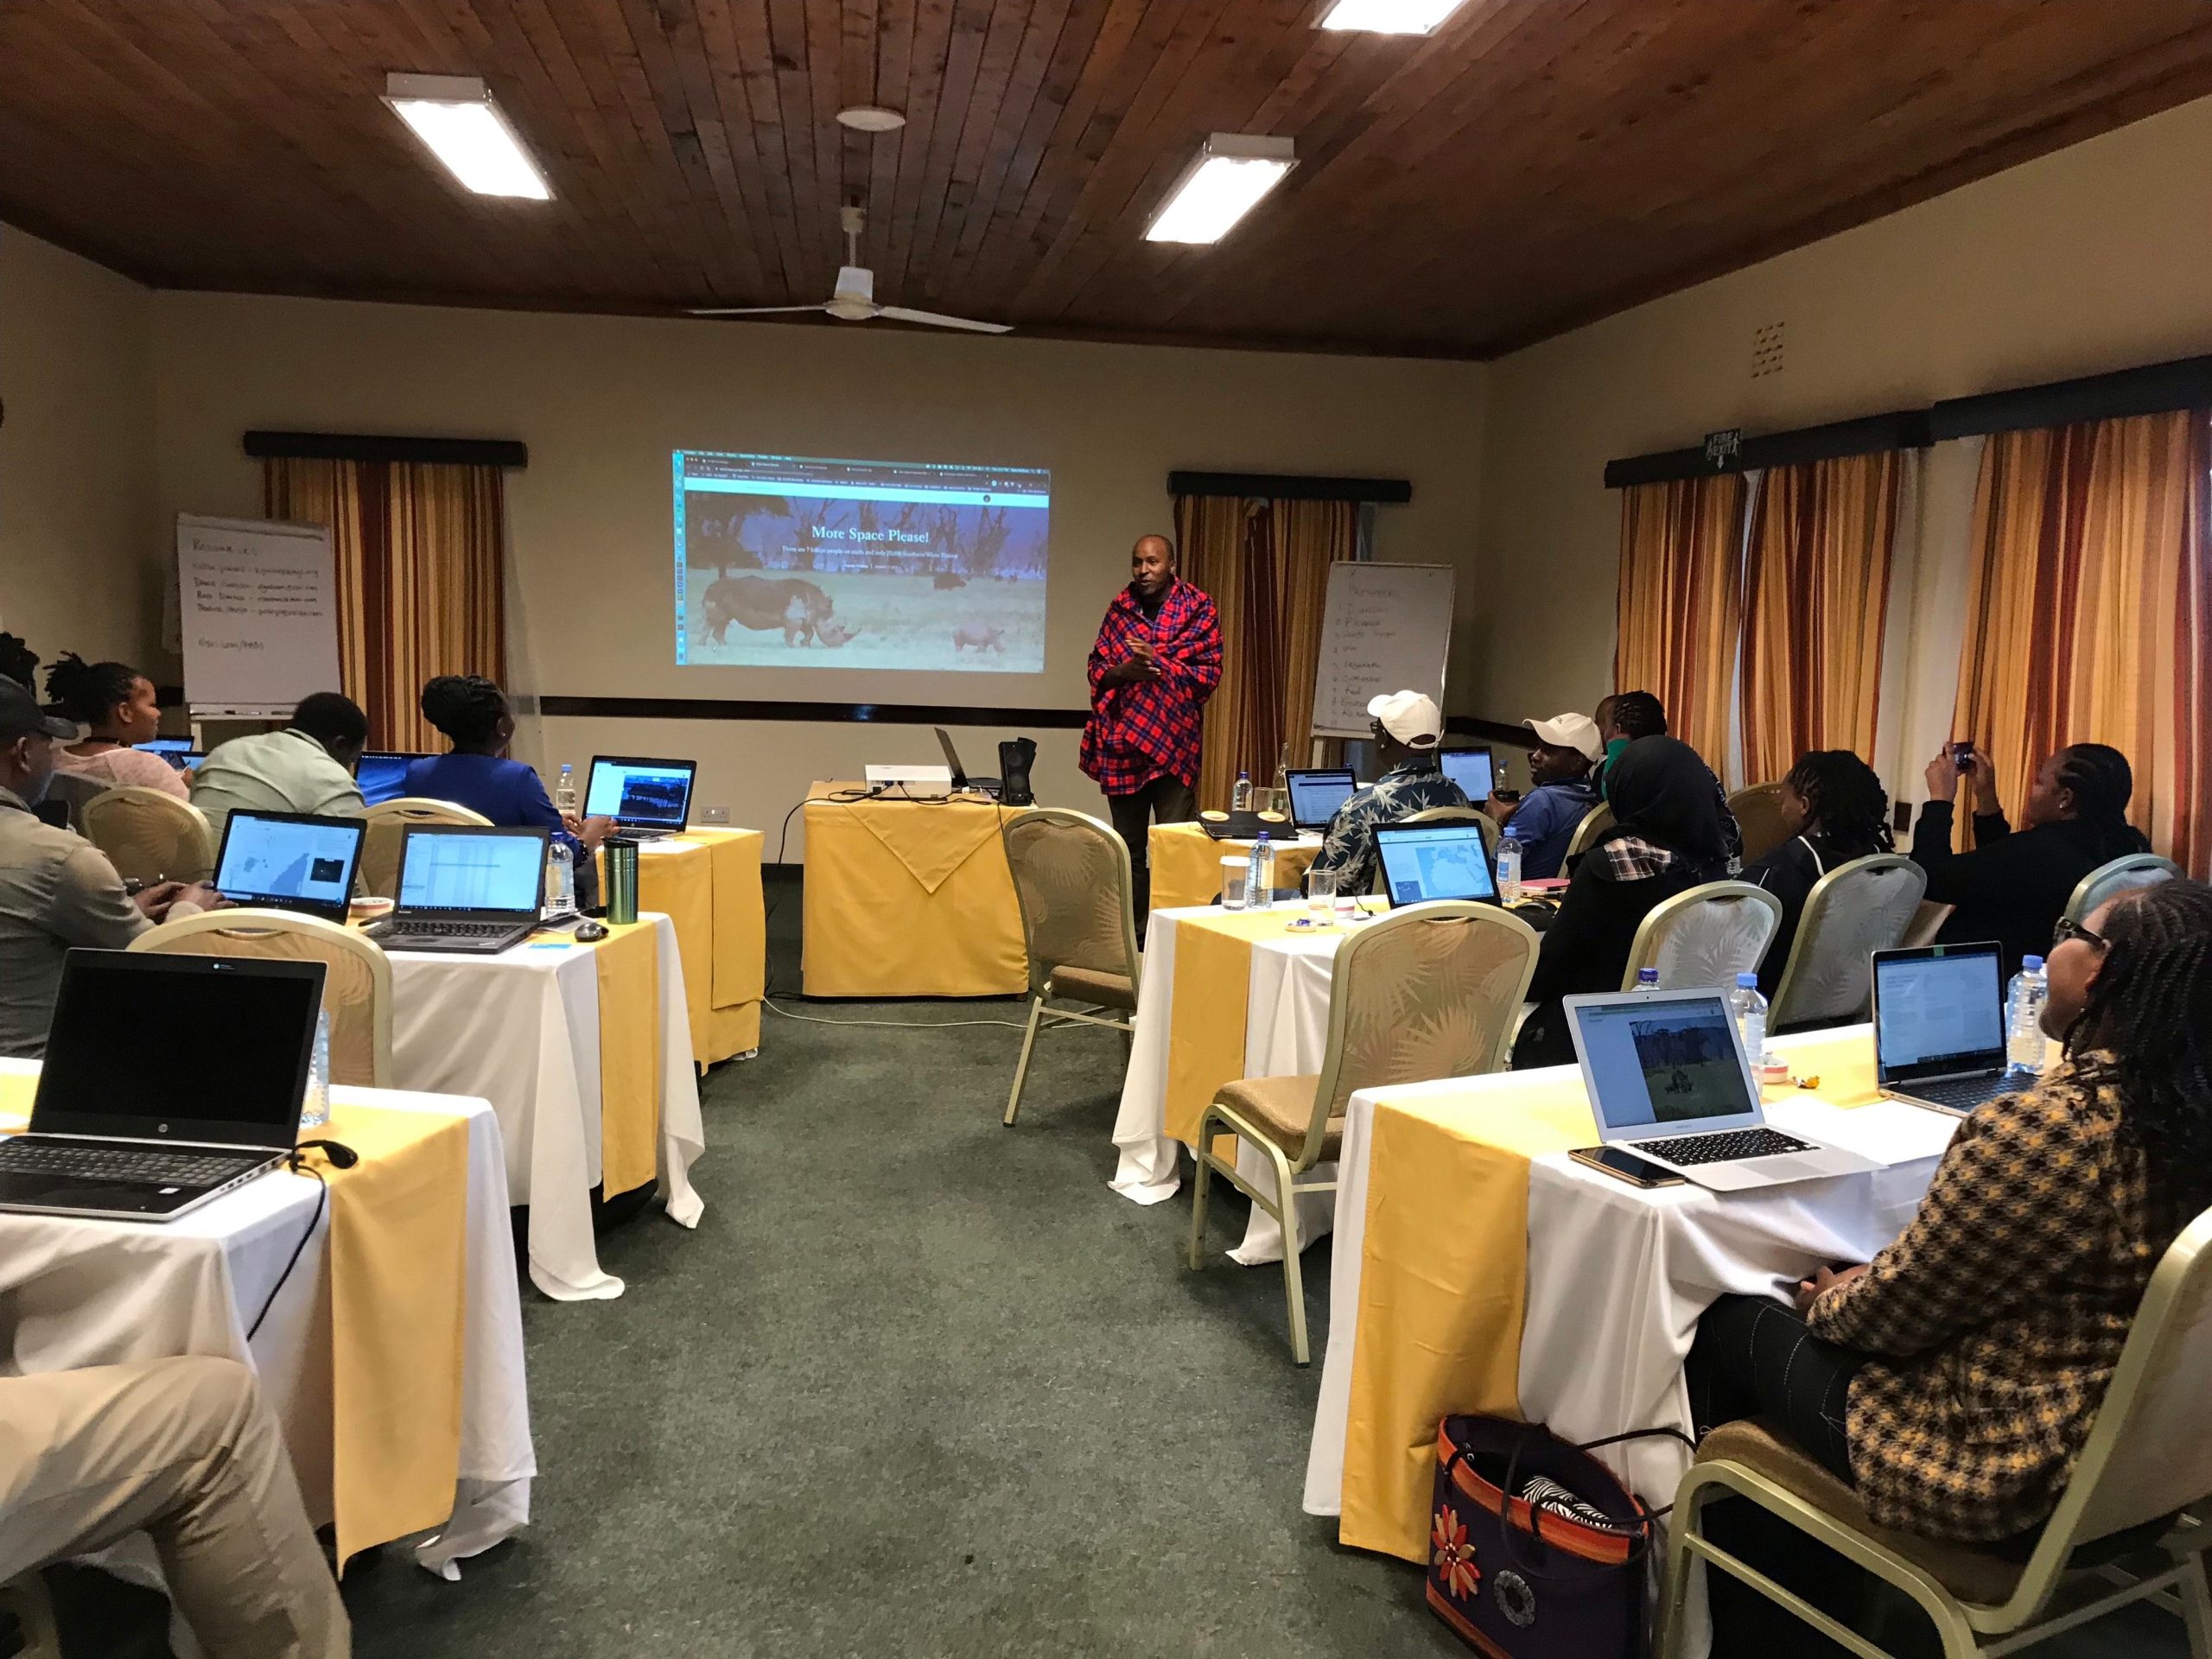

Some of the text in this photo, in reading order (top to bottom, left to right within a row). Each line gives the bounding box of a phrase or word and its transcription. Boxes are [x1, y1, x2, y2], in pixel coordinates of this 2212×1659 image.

[1713, 432, 1733, 444] FIRE
[1713, 442, 1732, 456] EXIT
[811, 525, 930, 544] More Space Please!
